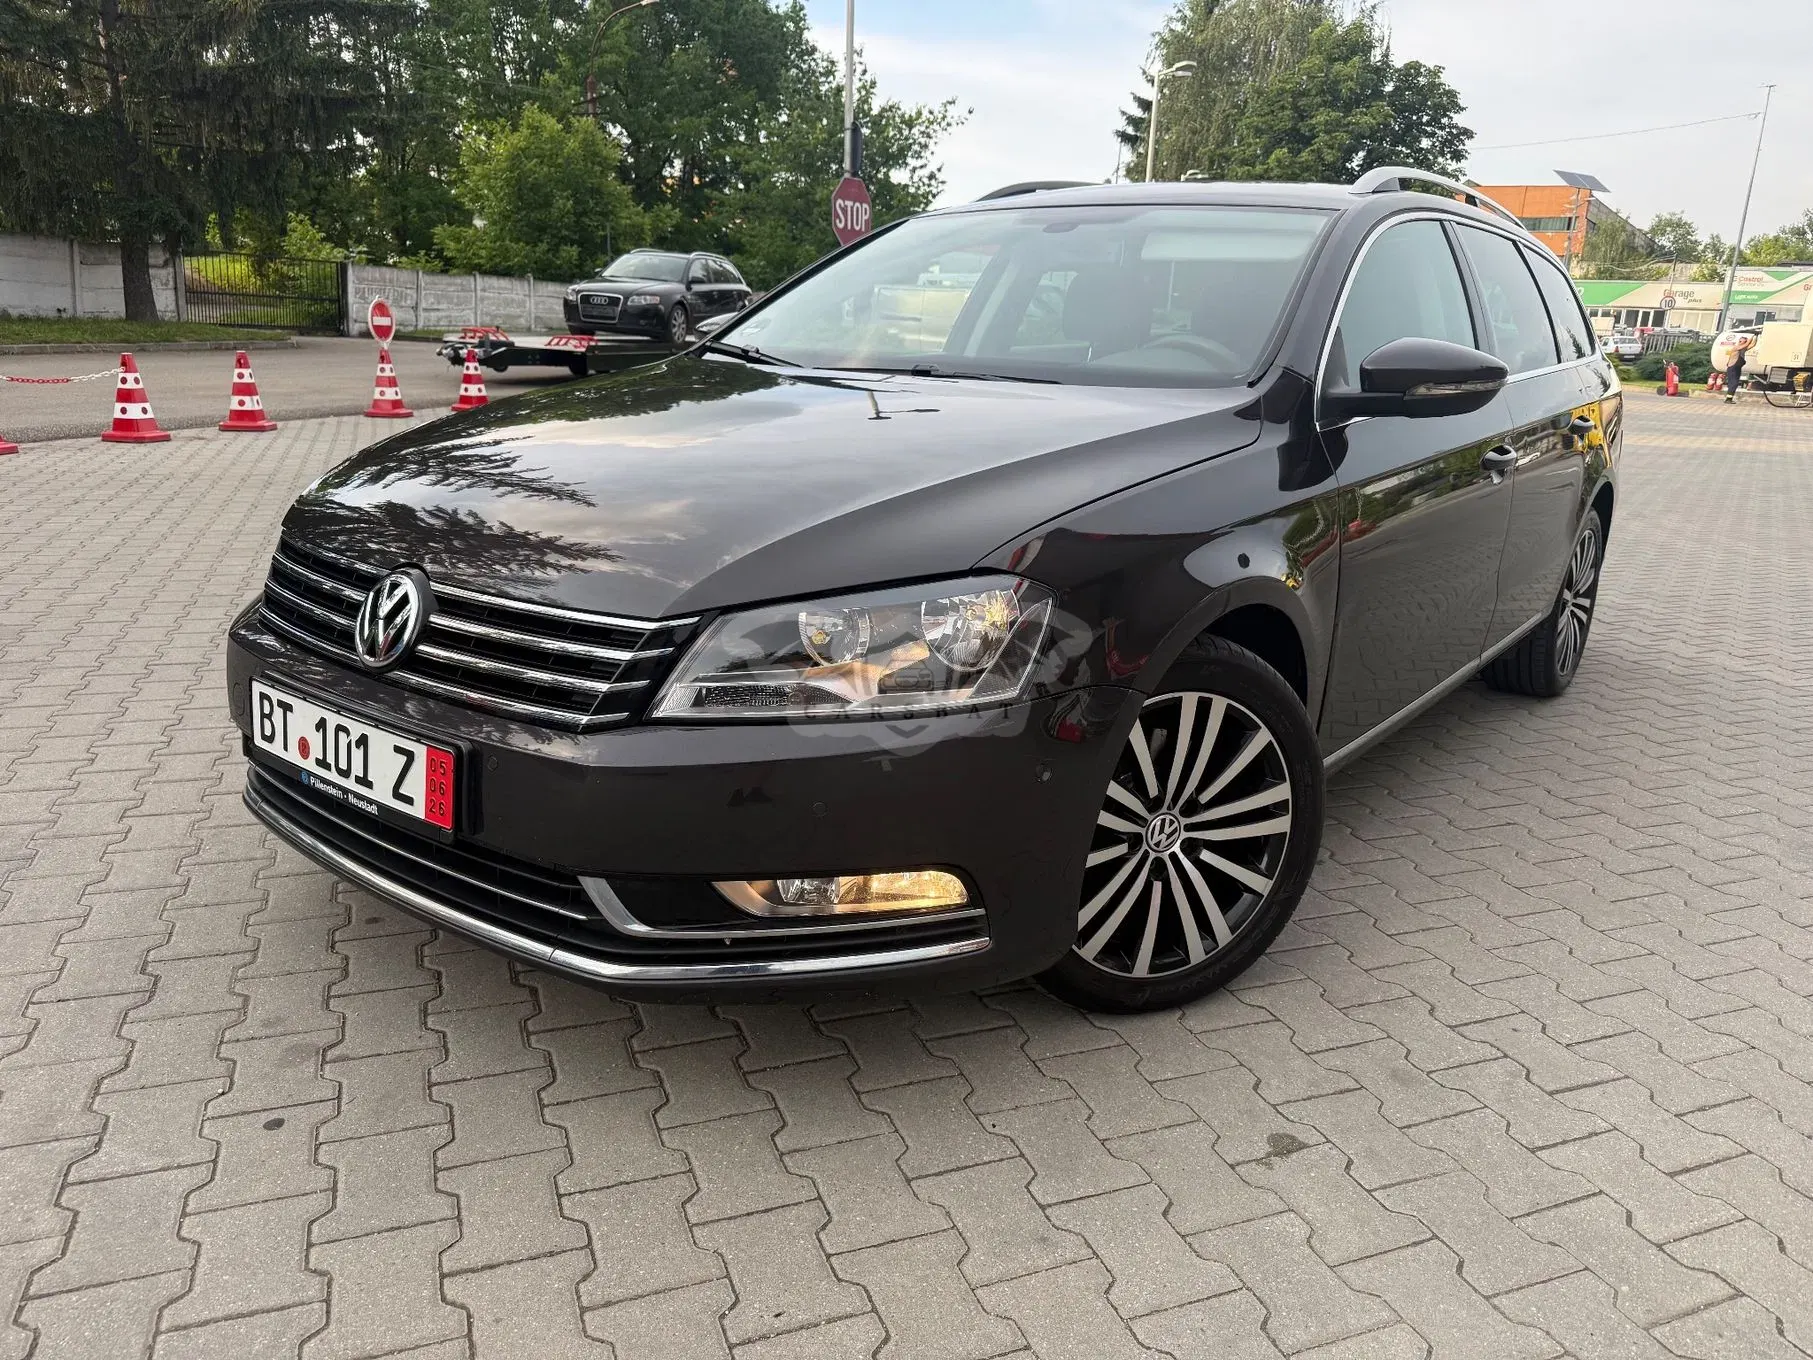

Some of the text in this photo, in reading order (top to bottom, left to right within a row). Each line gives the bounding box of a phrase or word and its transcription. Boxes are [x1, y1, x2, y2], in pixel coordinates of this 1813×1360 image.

[835, 198, 870, 232] STOP
[1663, 289, 1695, 300] Garage
[1664, 299, 1673, 308] 10
[259, 691, 415, 806] BT 101 Z
[430, 757, 446, 775] 05
[310, 775, 379, 816] Pillenstein Neustadt
[429, 777, 445, 796] 06
[429, 797, 445, 816] 26
